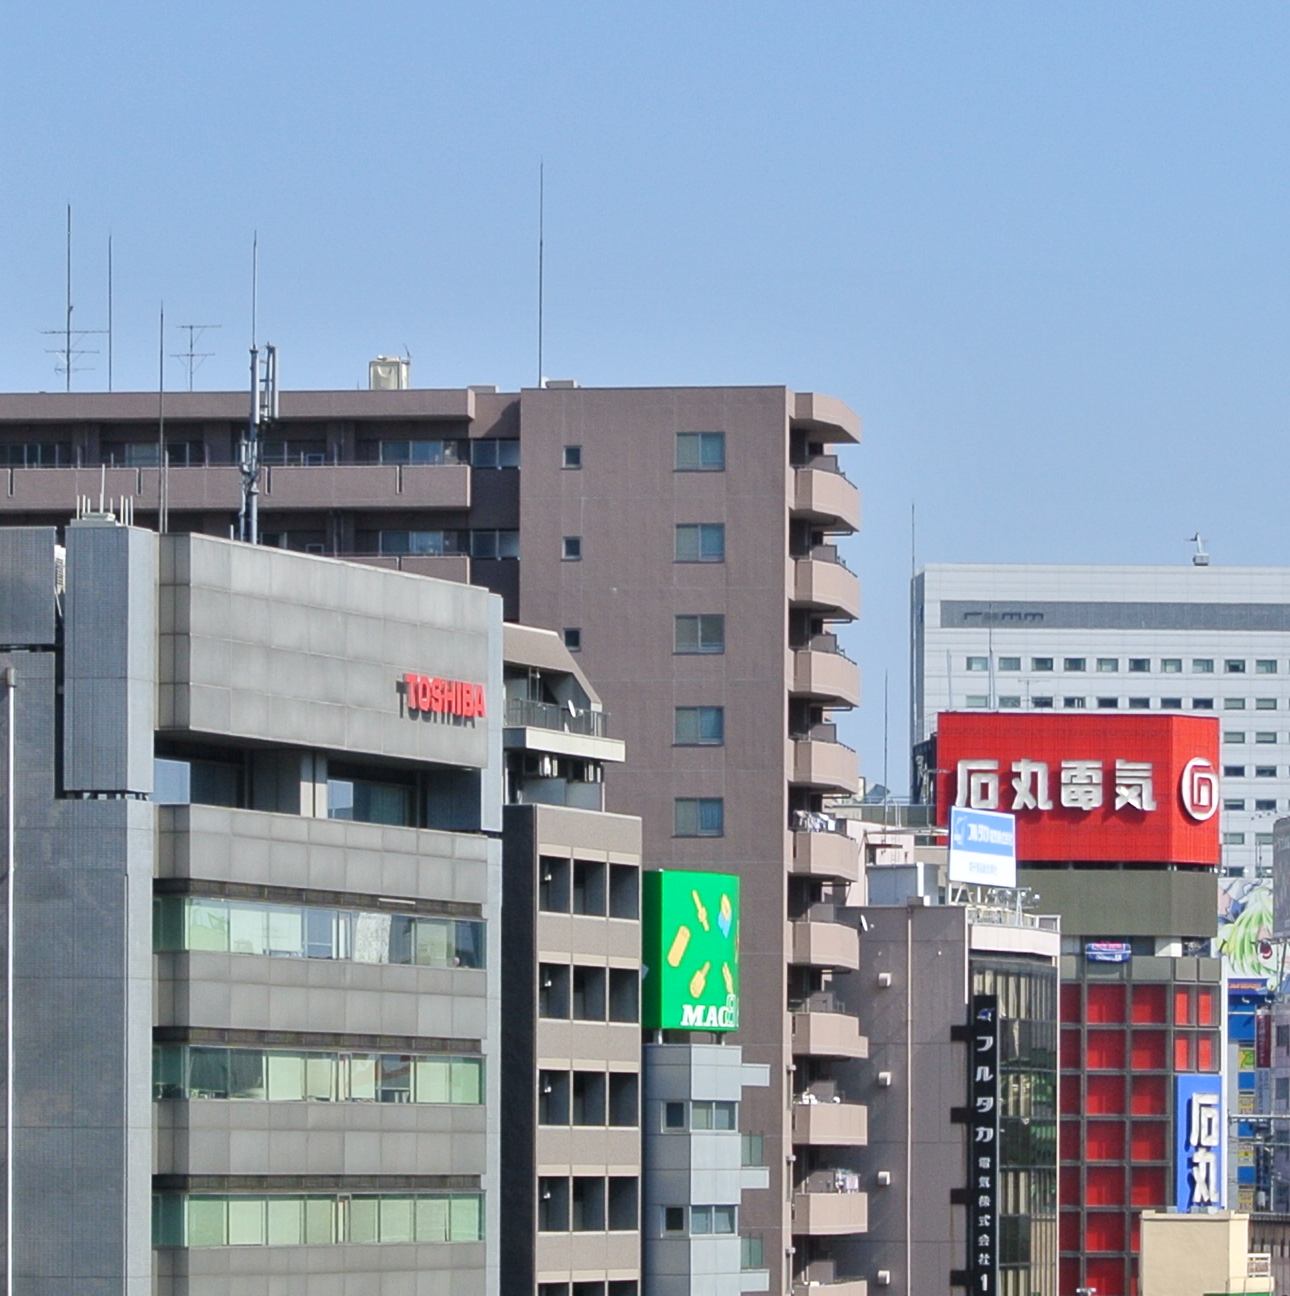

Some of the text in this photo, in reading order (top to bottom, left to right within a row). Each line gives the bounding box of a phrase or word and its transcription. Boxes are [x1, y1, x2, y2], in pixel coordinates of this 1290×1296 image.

[404, 673, 486, 718] TOSHIBA
[956, 759, 1157, 811] 石丸電気
[1189, 1093, 1220, 1204] 石丸
